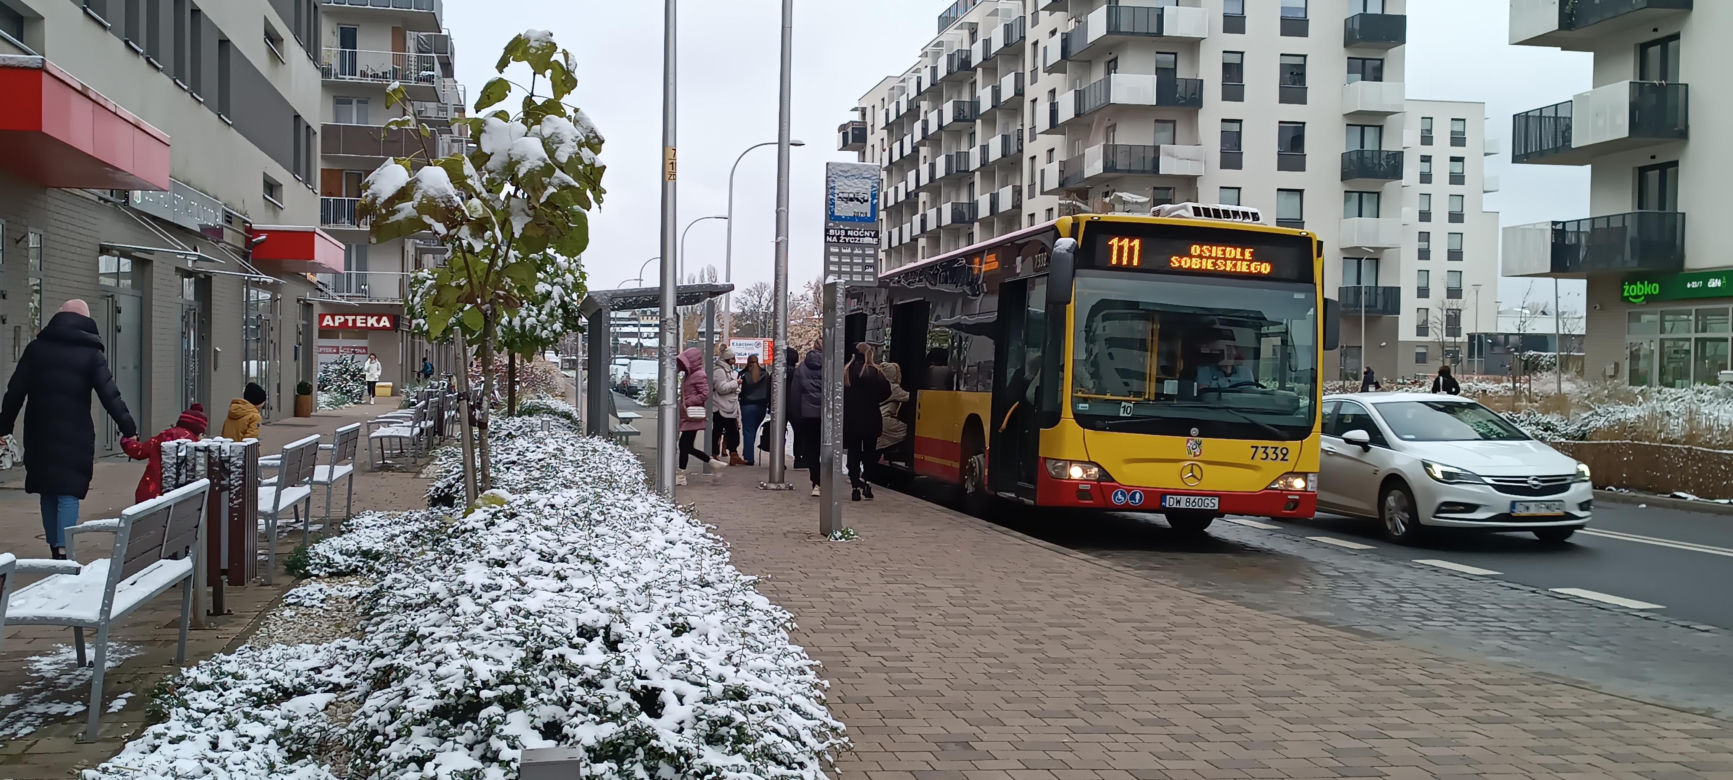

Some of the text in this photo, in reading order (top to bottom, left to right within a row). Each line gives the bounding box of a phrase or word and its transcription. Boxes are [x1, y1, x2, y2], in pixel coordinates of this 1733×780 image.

[826, 235, 837, 243] NA
[829, 228, 875, 236] BUS NOĆNY
[1108, 236, 1141, 266] 111
[1190, 244, 1254, 260] OSIEDLE
[1170, 256, 1272, 274] SOBIESKIEGO
[1623, 281, 1659, 297] żabka
[322, 315, 391, 327] APTEKA
[1121, 405, 1132, 415] 10
[1250, 445, 1290, 462] 7332
[1168, 496, 1216, 508] DW 860GS
